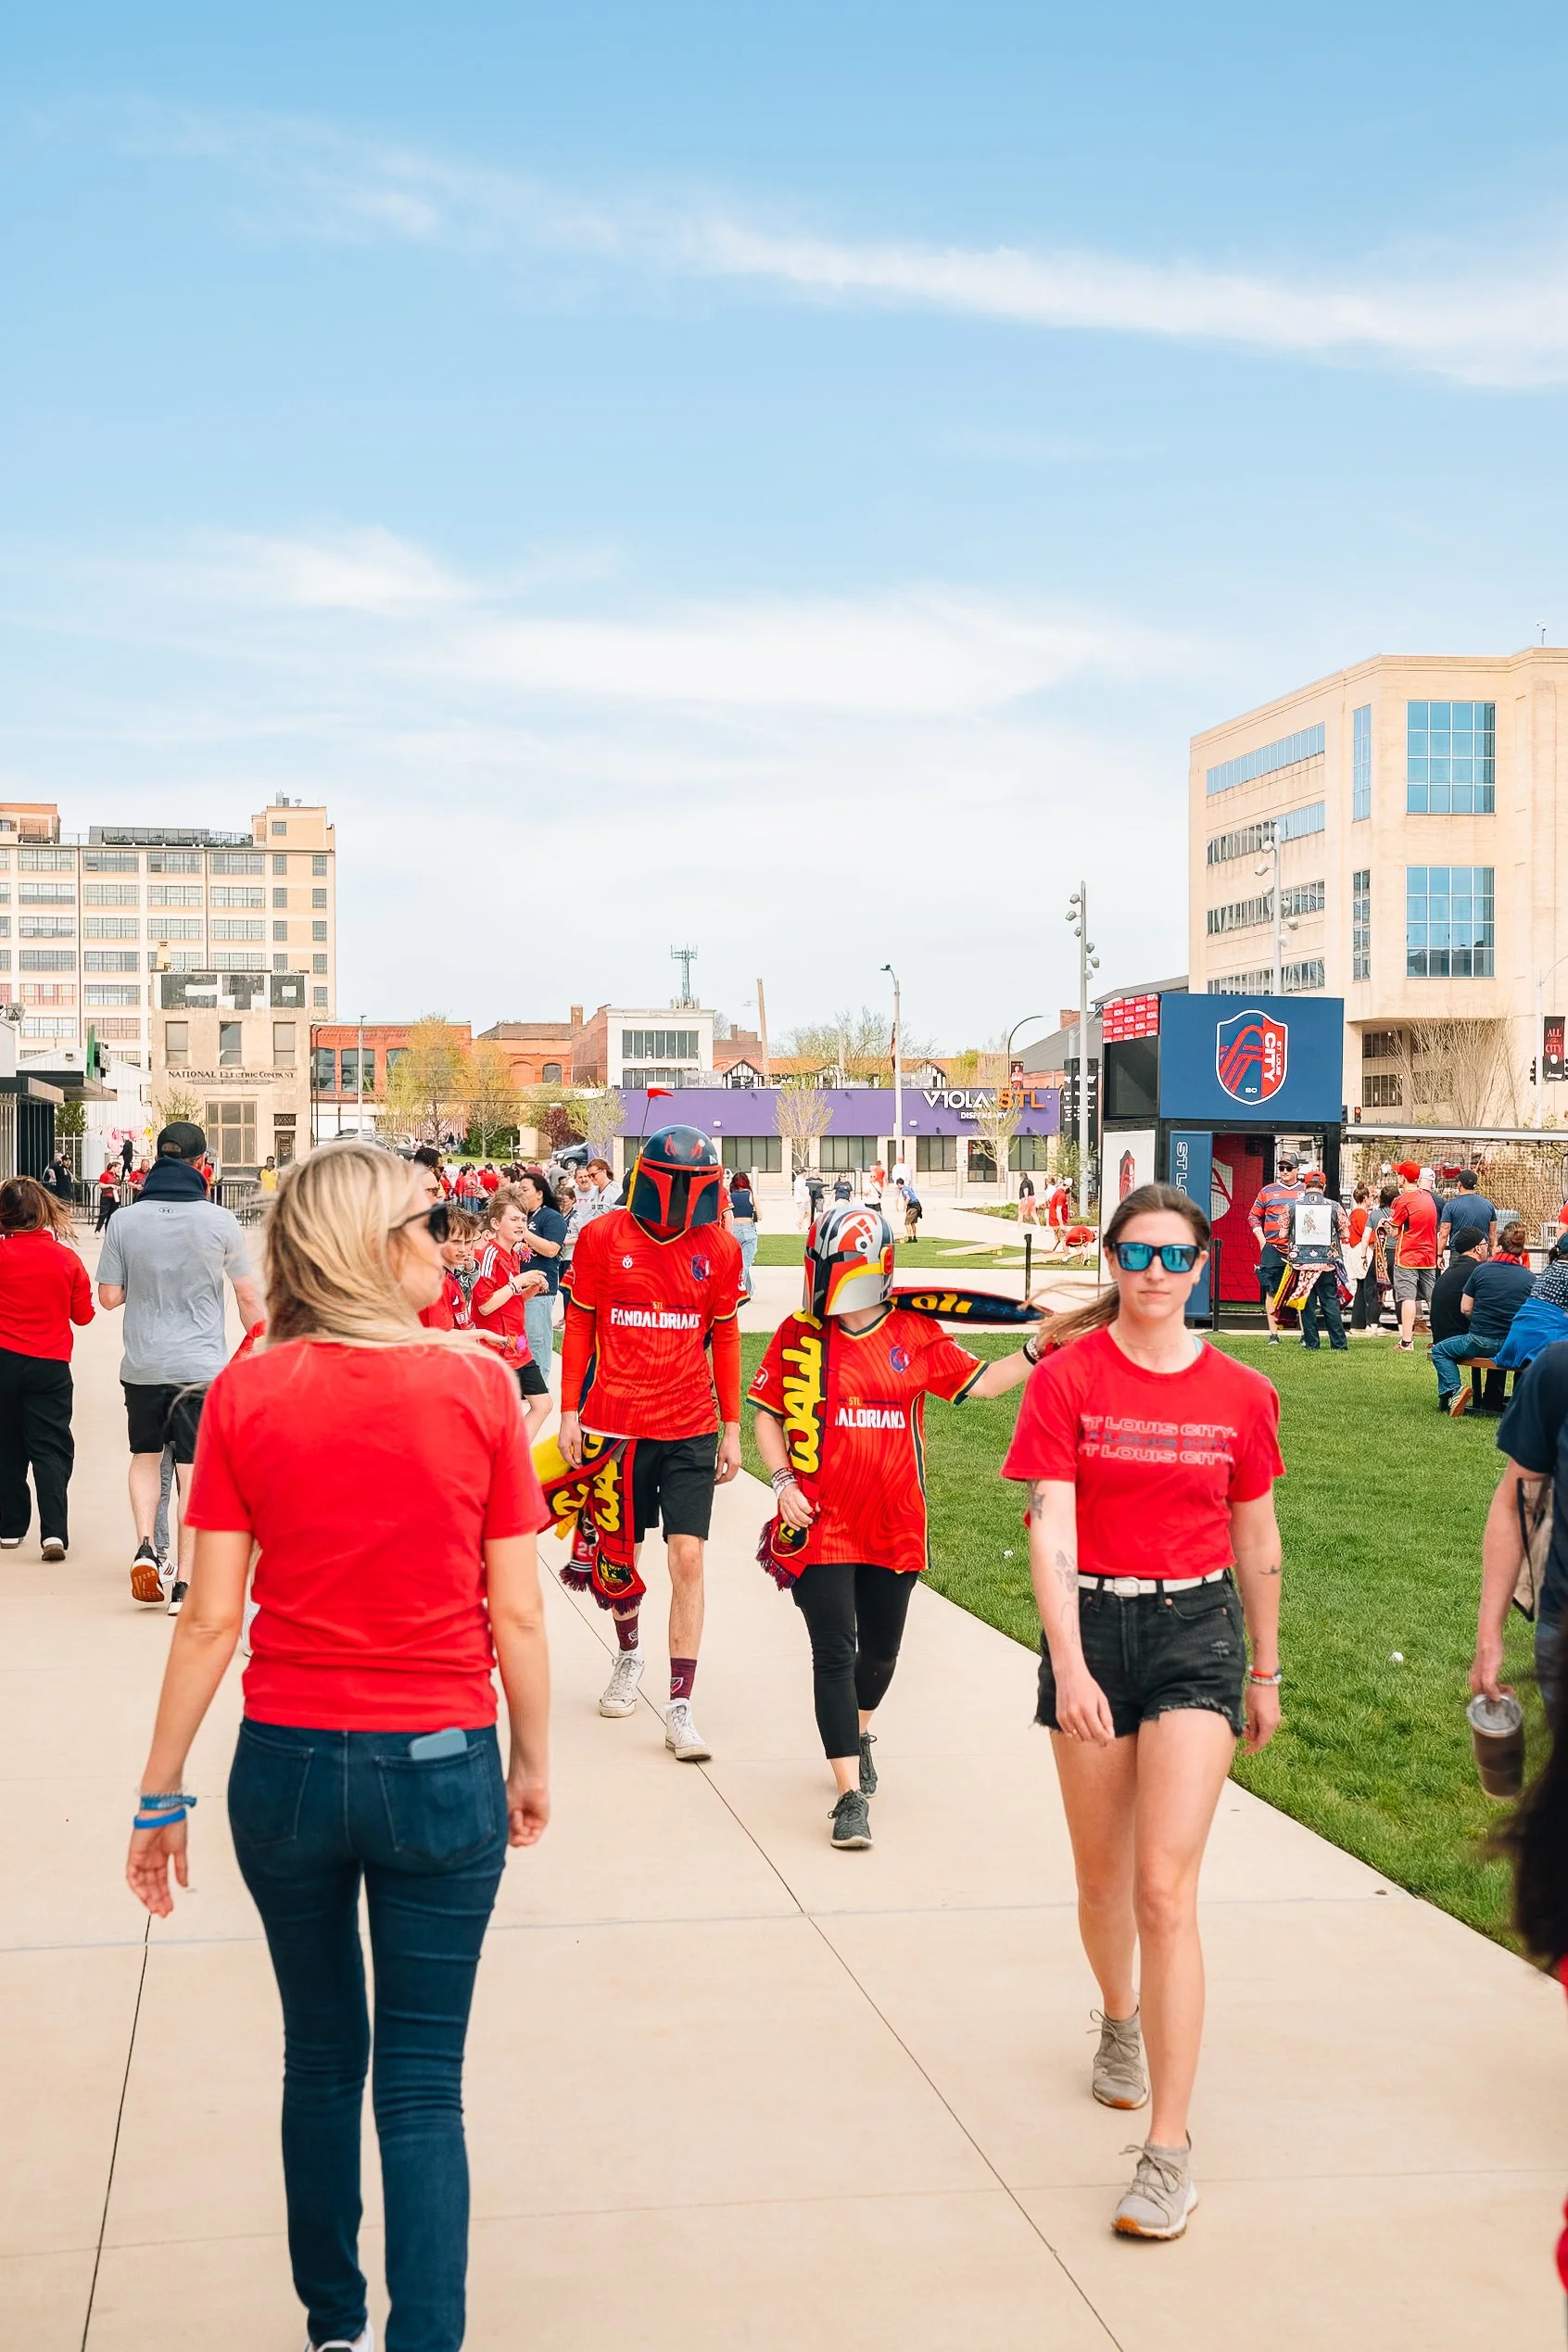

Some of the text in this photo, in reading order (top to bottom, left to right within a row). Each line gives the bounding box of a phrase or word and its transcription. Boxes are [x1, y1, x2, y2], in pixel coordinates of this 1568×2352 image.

[1547, 1028, 1562, 1038] ALL
[1263, 1031, 1276, 1082] CITY
[1545, 1043, 1562, 1054] CITY
[922, 1089, 1045, 1109] VIOLA STL
[1176, 1141, 1188, 1170] ST
[611, 1308, 702, 1329] FANDALORIANS
[849, 1397, 861, 1406] STL
[1105, 1416, 1178, 1435] LOUIS
[1100, 1445, 1177, 1463] LOUIS
